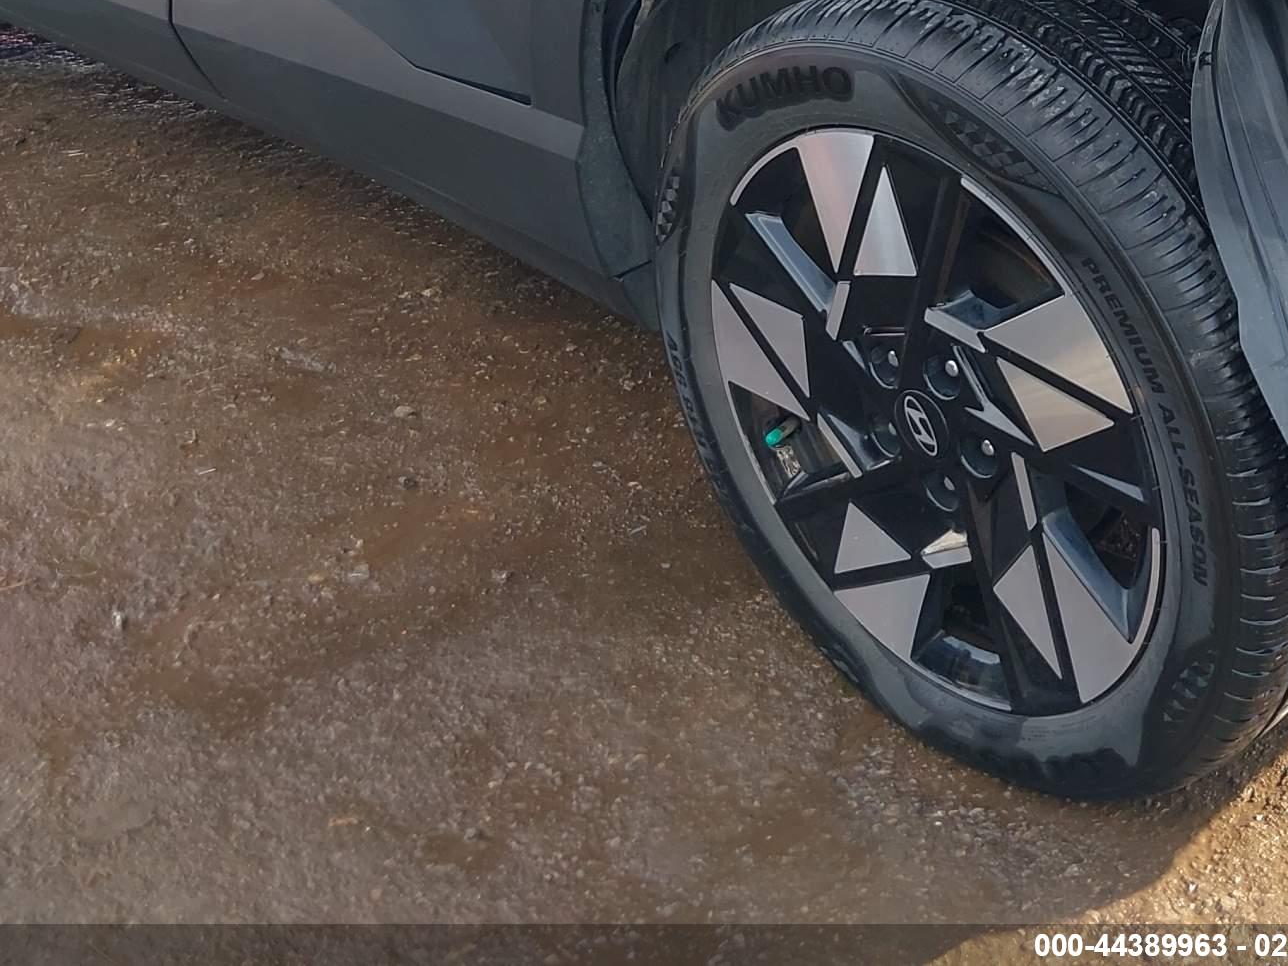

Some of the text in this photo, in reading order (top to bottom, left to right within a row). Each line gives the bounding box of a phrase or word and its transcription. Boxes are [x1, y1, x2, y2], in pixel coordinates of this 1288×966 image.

[716, 65, 856, 126] KUMHO
[1080, 257, 1209, 588] PREMIUM ALL-SEASON
